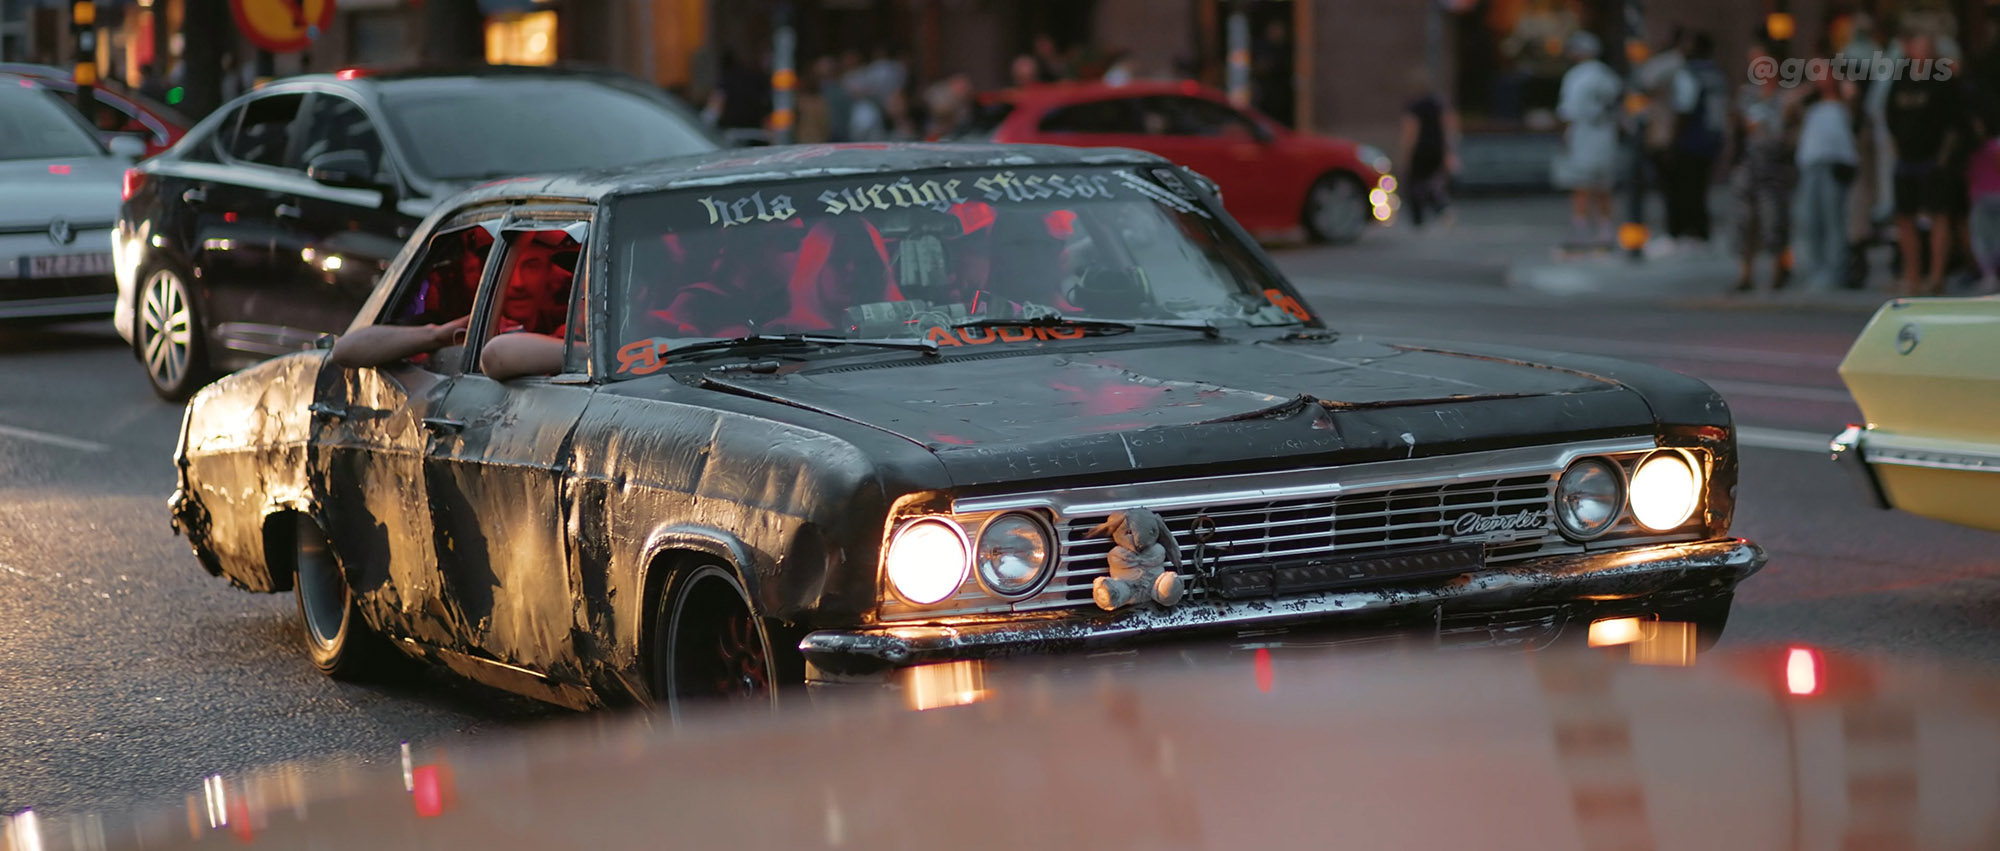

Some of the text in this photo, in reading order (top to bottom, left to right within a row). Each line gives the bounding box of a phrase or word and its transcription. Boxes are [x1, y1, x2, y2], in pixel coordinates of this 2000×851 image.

[698, 190, 797, 228] hela
[817, 176, 966, 213] sverige
[1453, 508, 1546, 535] Chevrolet
